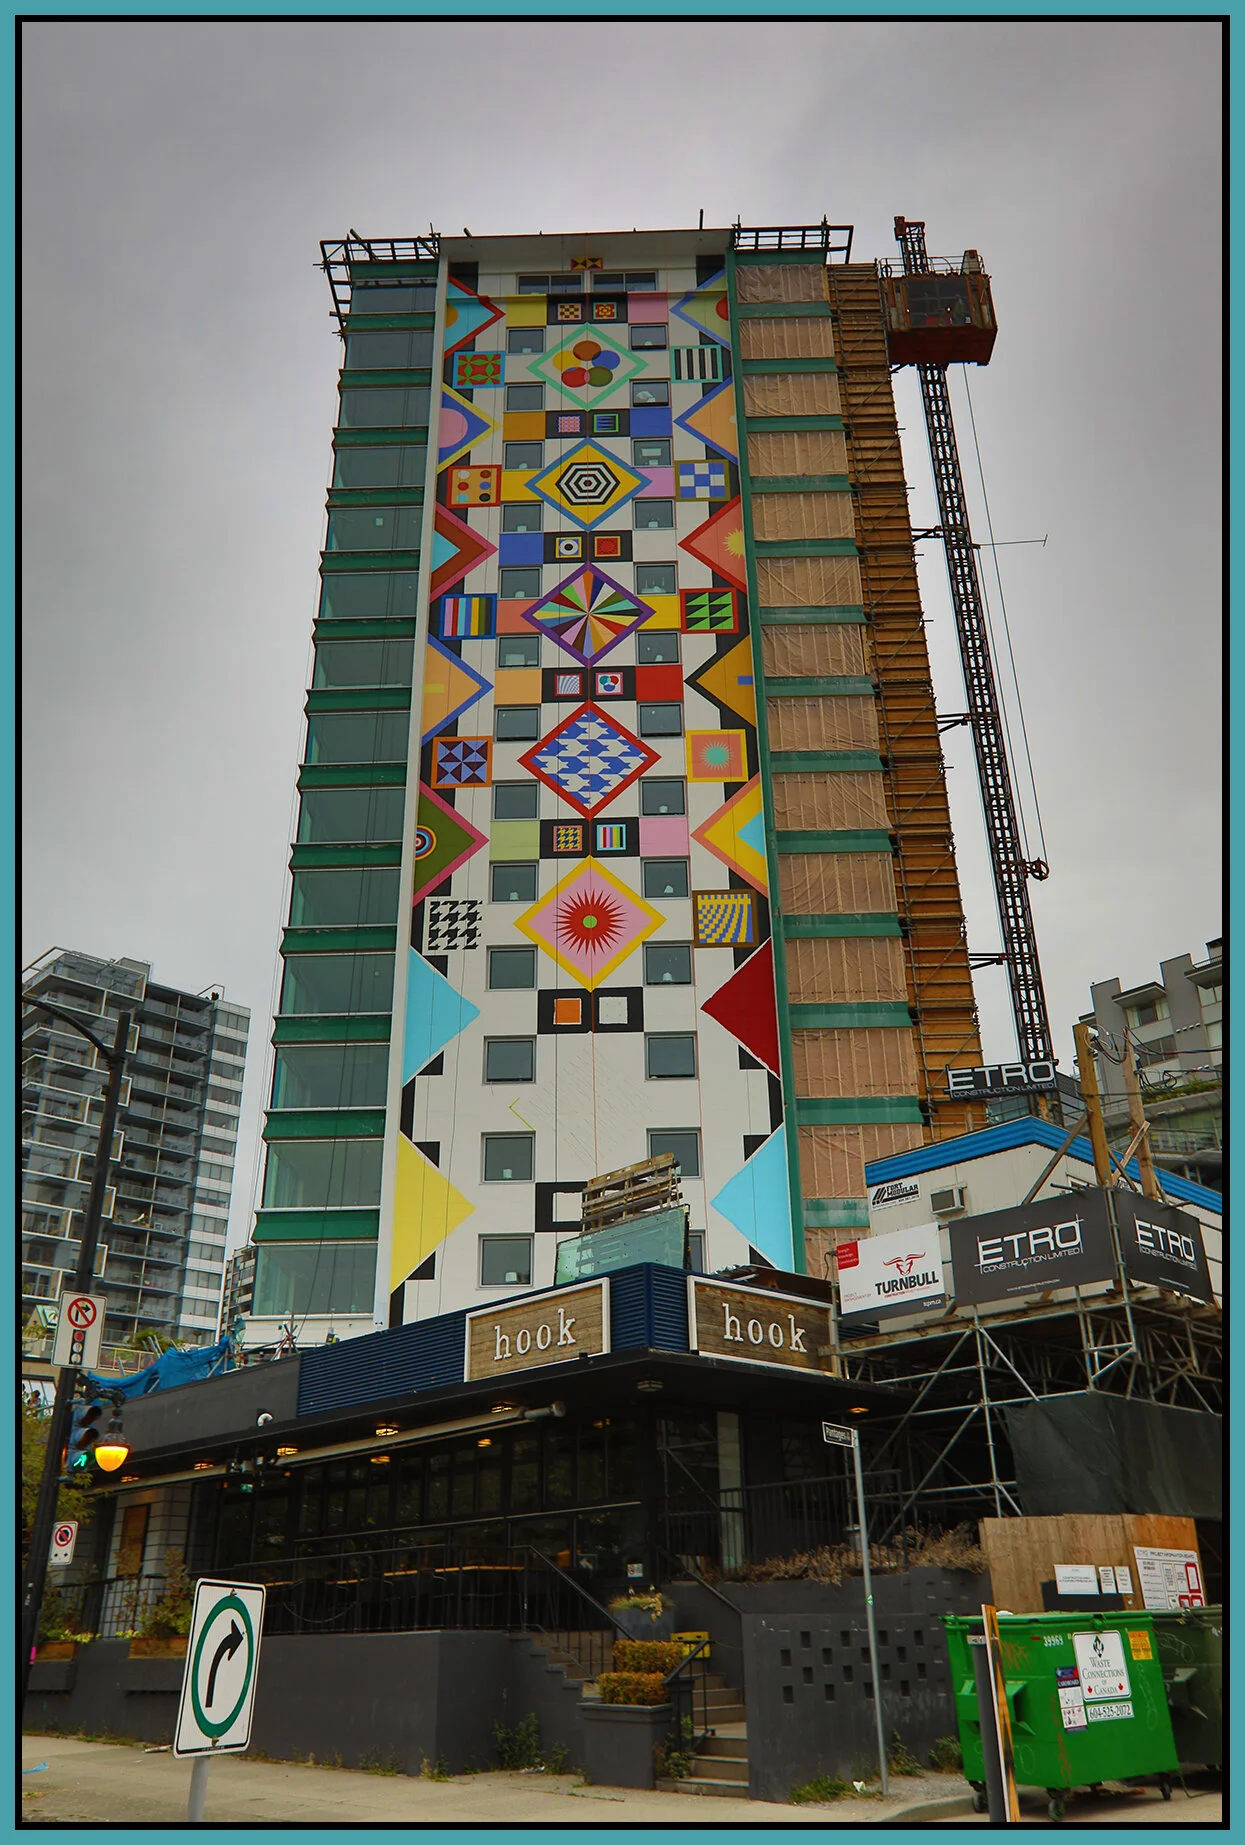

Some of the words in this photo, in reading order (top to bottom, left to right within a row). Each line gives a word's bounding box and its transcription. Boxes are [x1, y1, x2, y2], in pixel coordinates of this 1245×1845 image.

[948, 1061, 1055, 1091] ETRO
[953, 1085, 1021, 1098] CONSTRUCTION
[1021, 1082, 1054, 1091] LIMITED
[886, 1182, 903, 1192] FORT
[887, 1184, 919, 1197] MODULAR
[978, 1221, 1081, 1266] ETRO
[1135, 1219, 1195, 1261] ETRO
[983, 1254, 1047, 1273] CONSTRUCTION
[1047, 1247, 1080, 1260] LIMITED
[875, 1271, 939, 1295] TURNBULL
[494, 1308, 576, 1360] hook
[722, 1303, 808, 1353] hook
[1089, 1657, 1111, 1668] WASTE
[1082, 1667, 1125, 1680] CONNECTIONS
[1094, 1685, 1118, 1696] CANADA
[1089, 1704, 1132, 1720] 604-525-2072
